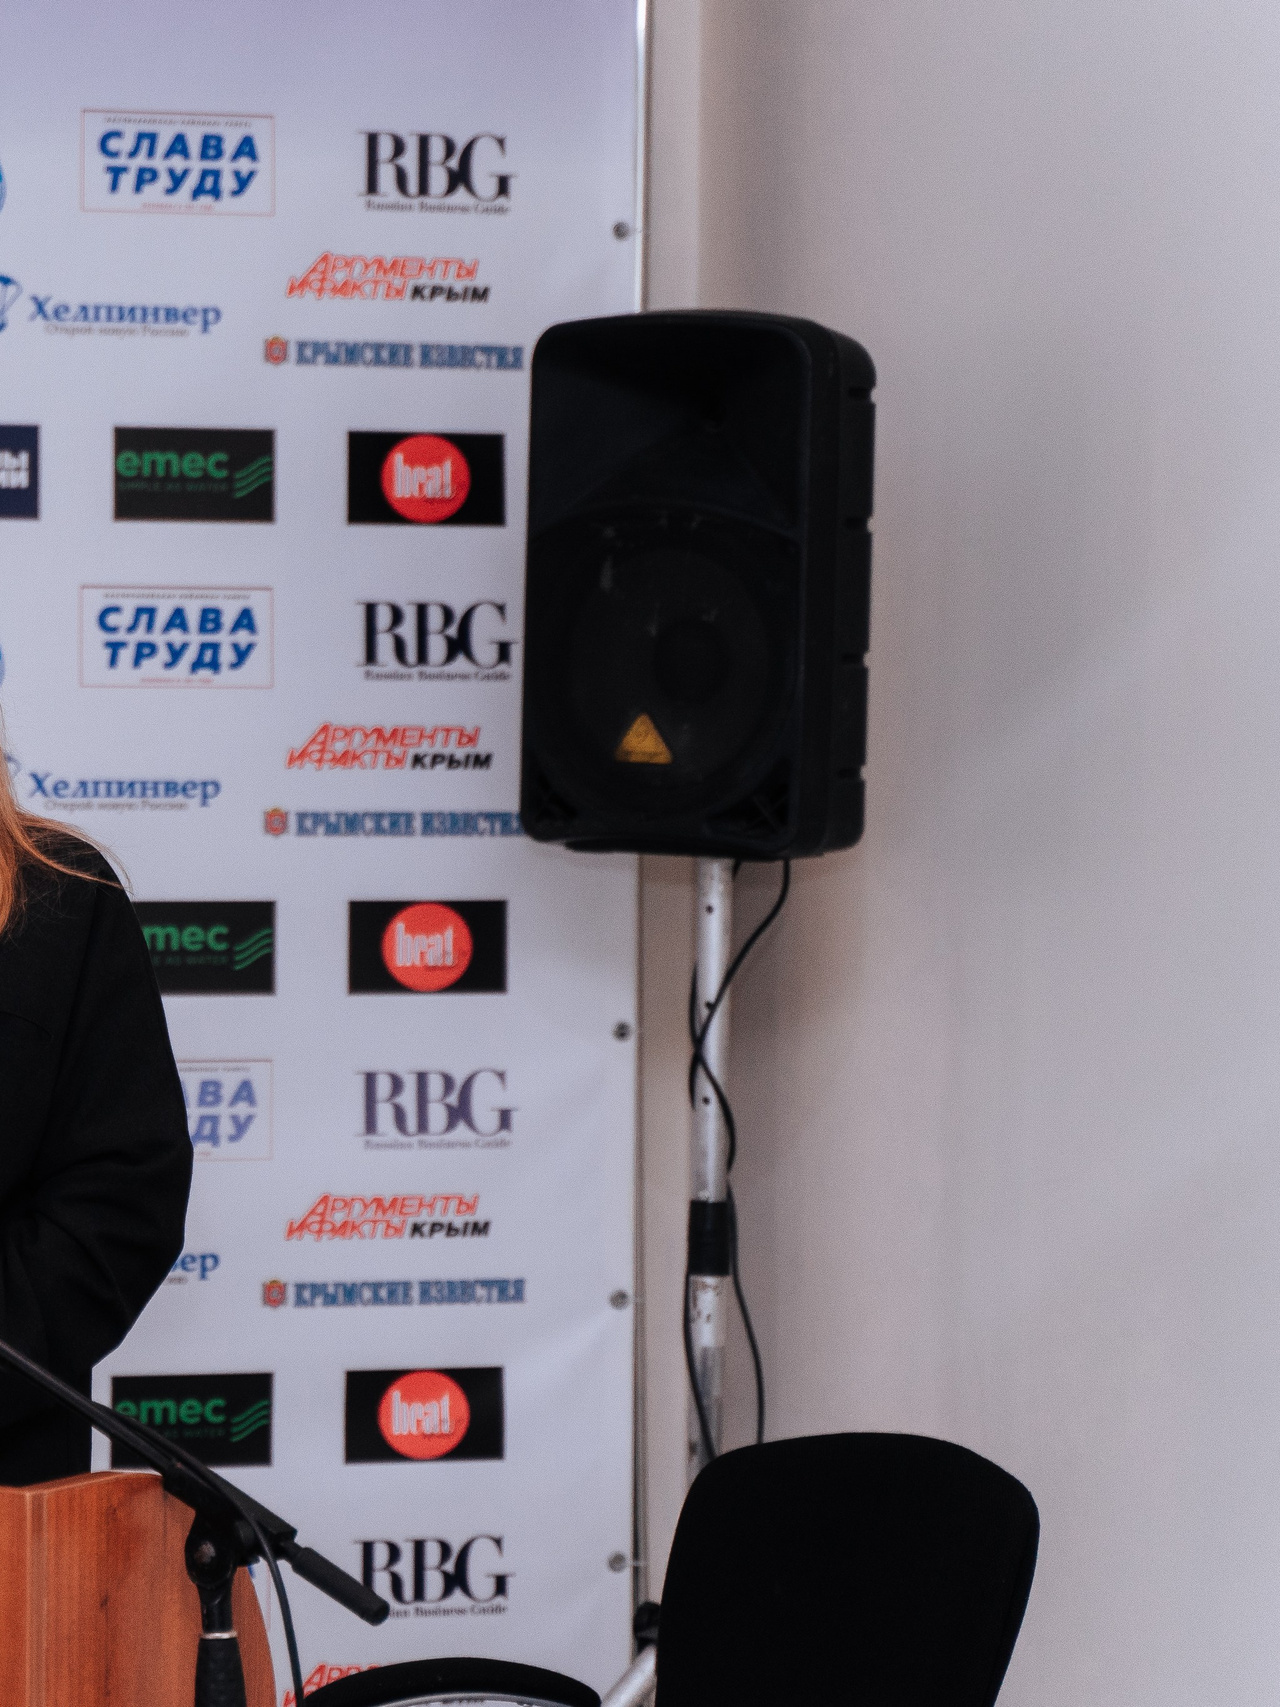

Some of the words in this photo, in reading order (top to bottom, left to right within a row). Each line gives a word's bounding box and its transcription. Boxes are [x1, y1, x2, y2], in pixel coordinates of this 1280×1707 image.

[99, 131, 260, 163] СЛАВА
[357, 131, 516, 201] RBG
[106, 166, 259, 201] ТРУДУ
[411, 284, 490, 304] КРЫМ
[29, 294, 222, 334] Хелпинвер
[295, 341, 414, 368] КРЫМСКИЕ
[420, 343, 524, 370] ИЗВЕСТИЯ
[116, 449, 228, 479] emec
[97, 606, 258, 637] СЛАВА
[356, 601, 518, 670] RBG
[105, 642, 257, 675] ТРУДУ
[411, 752, 492, 771] КРЫМ
[29, 772, 221, 807] Хелпинвер
[295, 812, 414, 836] КРЫМСКИЕ
[142, 925, 228, 951] mec
[355, 1069, 518, 1139] RBG
[410, 1220, 490, 1239] КРЫМ
[294, 1281, 414, 1307] КРЫМСКИЕ
[420, 1279, 526, 1305] ИЗВЕСТИЯ
[354, 1534, 515, 1605] RBG
